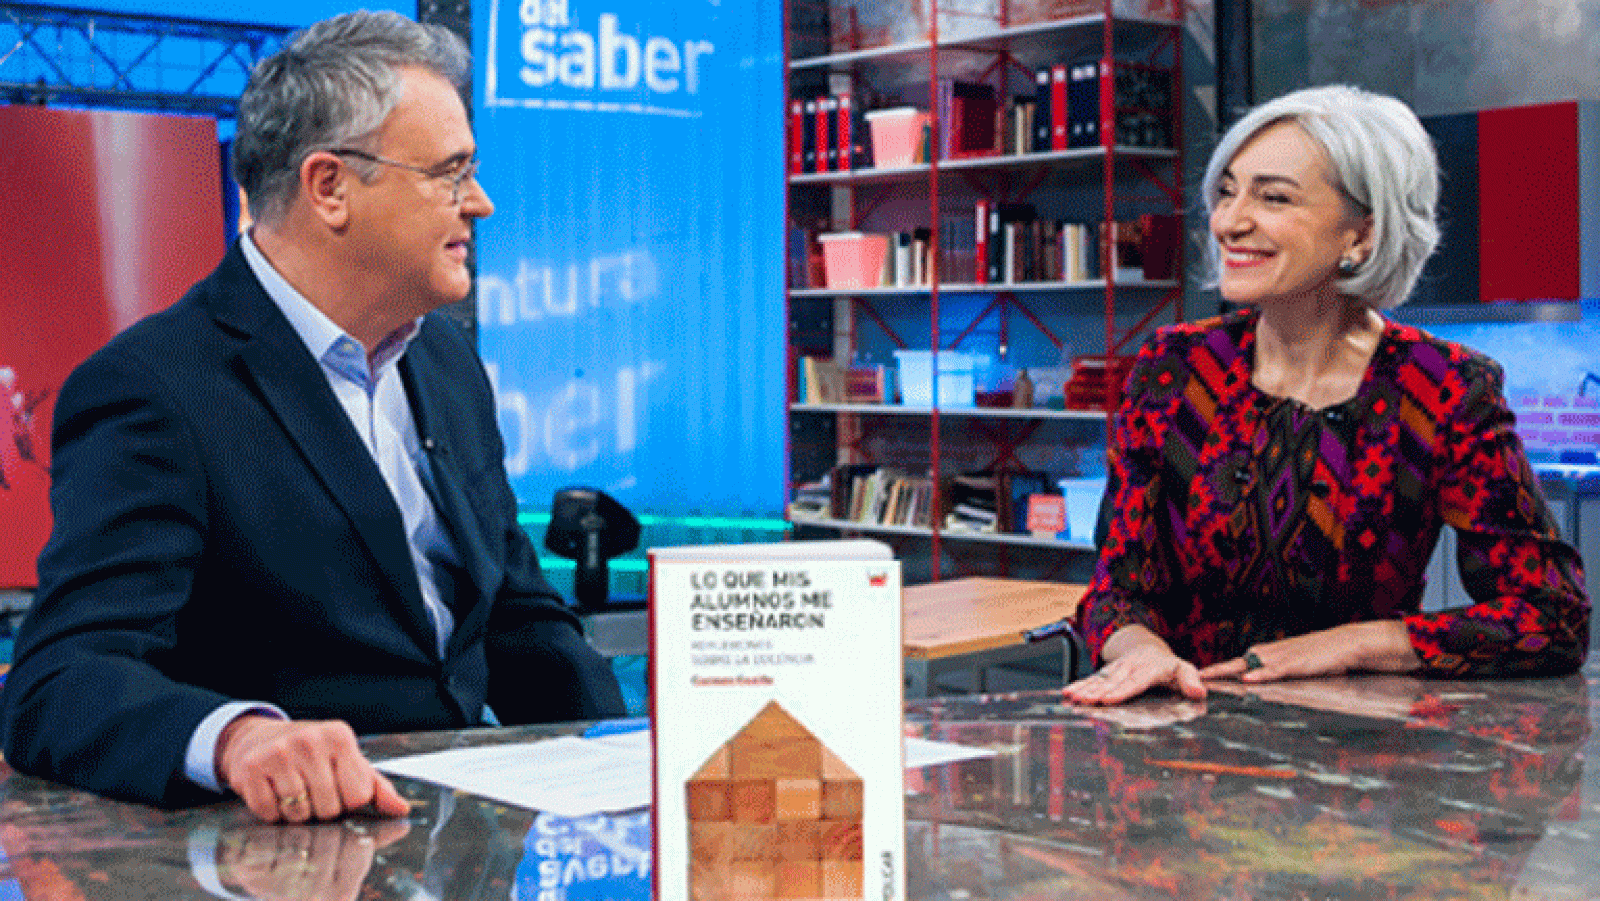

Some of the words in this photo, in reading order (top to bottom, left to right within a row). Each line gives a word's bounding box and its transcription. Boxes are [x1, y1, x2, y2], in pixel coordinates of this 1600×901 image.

[519, 13, 714, 94] saber
[690, 571, 718, 590] LO
[722, 570, 766, 589] QUE
[772, 571, 812, 588] MIS
[690, 592, 796, 611] ALUMNOS
[800, 590, 834, 609] ME
